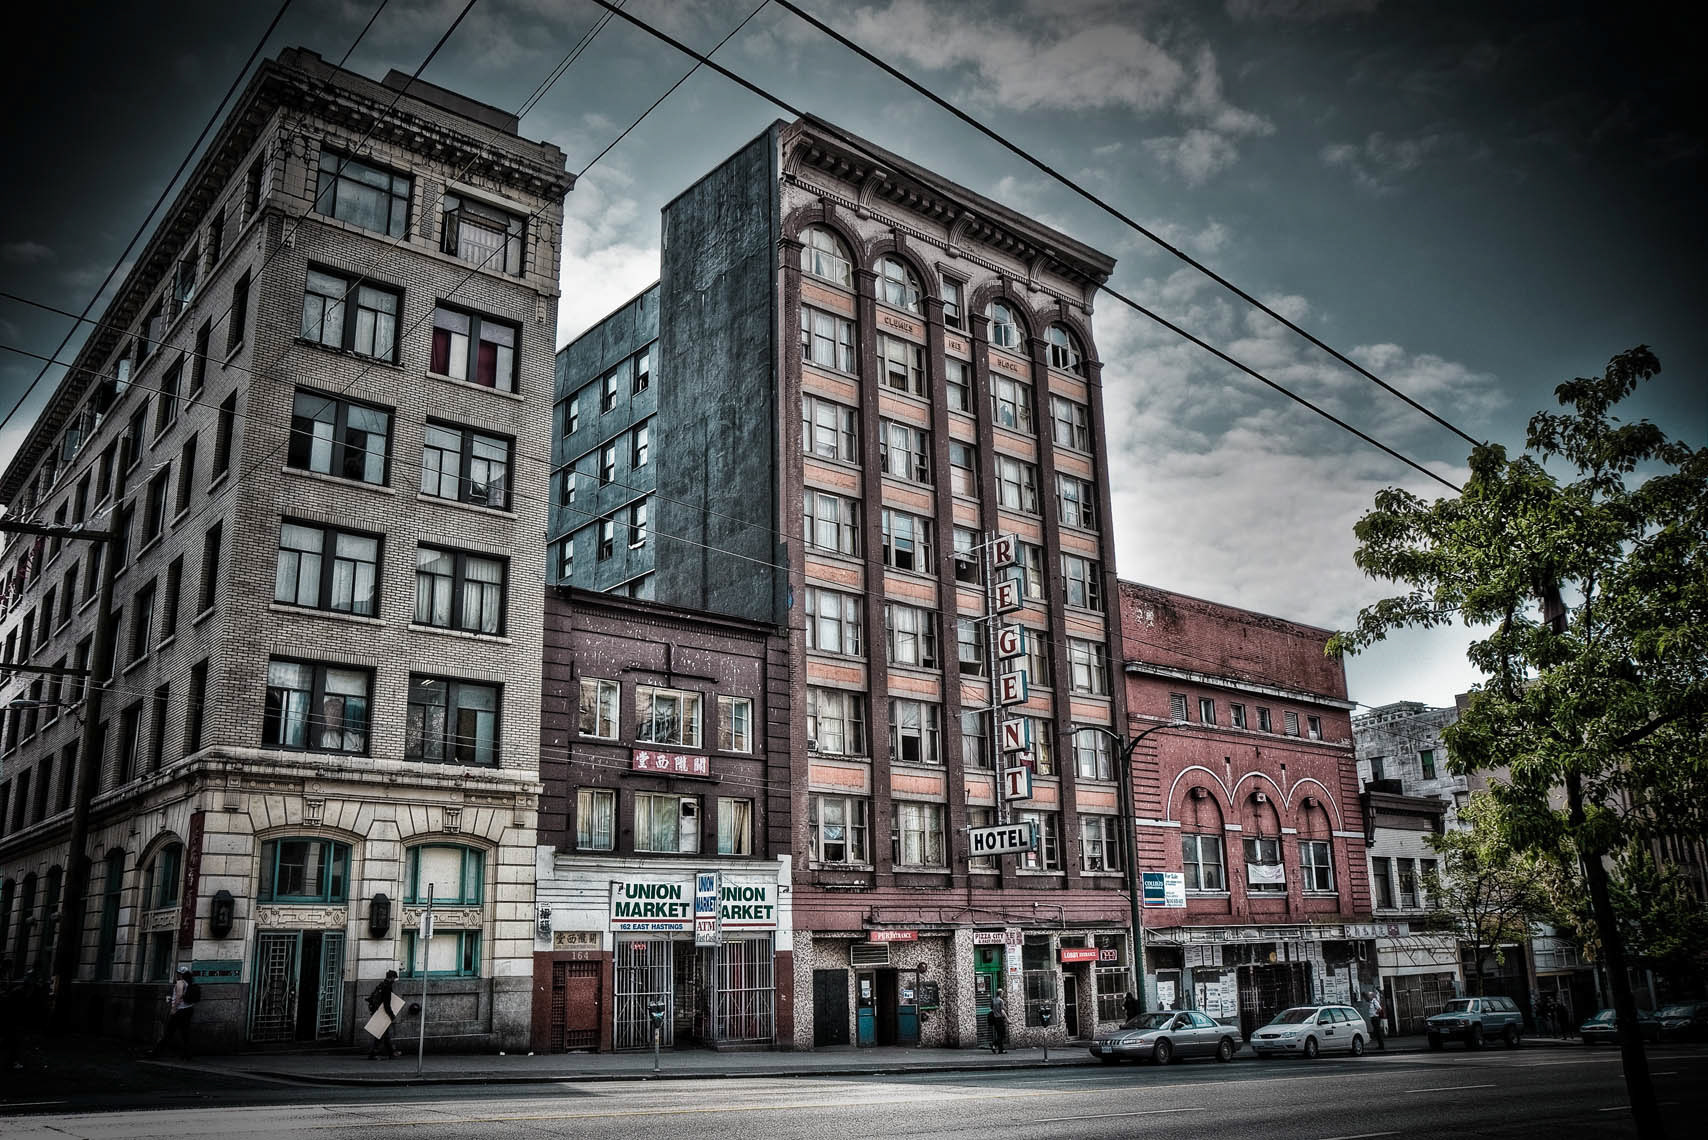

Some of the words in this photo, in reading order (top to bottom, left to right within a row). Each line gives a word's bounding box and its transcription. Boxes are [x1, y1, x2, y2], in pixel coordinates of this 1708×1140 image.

[996, 540, 1023, 797] REGENT
[974, 828, 1028, 851] HOTEL
[625, 883, 682, 900] UNION
[698, 876, 714, 892] UNION
[615, 902, 690, 918] MARKET
[696, 896, 716, 912] MARKET
[722, 905, 773, 919] ARKET
[697, 921, 716, 931] ATM
[571, 951, 589, 960] 164
